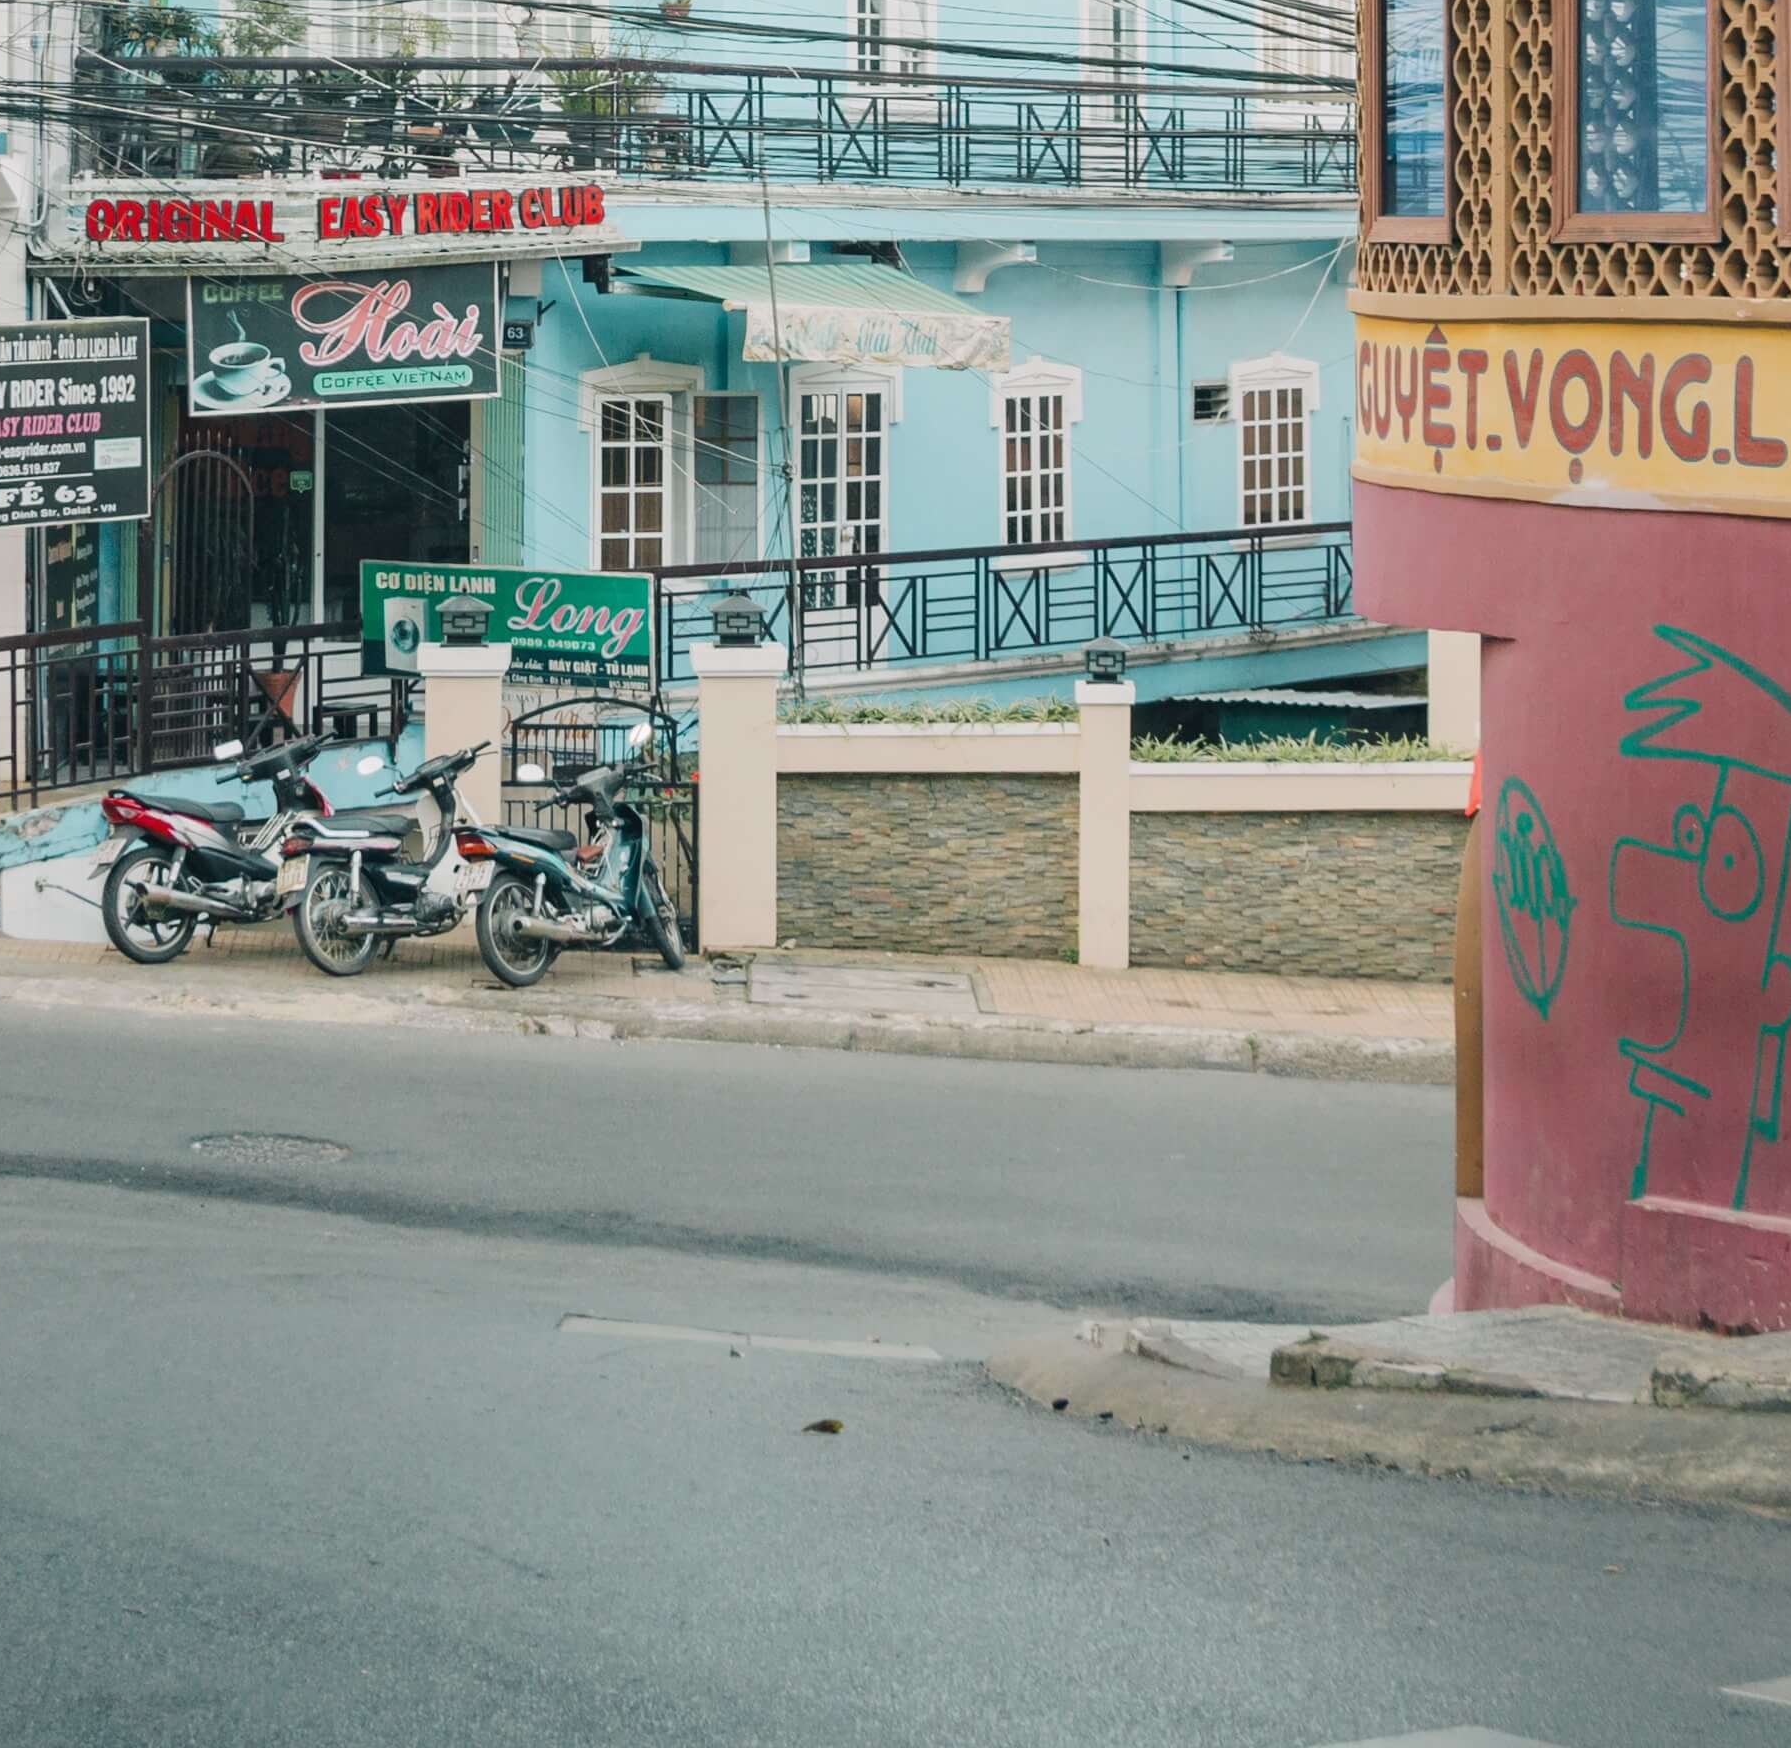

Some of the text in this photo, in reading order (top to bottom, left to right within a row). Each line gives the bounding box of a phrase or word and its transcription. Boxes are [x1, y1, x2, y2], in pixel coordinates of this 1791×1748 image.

[85, 184, 606, 244] ORIGINAL EASY RIDER CLUB
[291, 279, 484, 367] Hoài
[507, 327, 524, 339] 63
[10, 378, 55, 409] RIDER
[58, 376, 97, 407] Since
[100, 374, 136, 404] 1992
[22, 414, 64, 437] RIDER
[66, 411, 102, 433] CLUB
[55, 485, 98, 504] 63
[11, 509, 38, 521] Dinh
[62, 504, 91, 517] Dalat
[100, 502, 117, 514] VN
[375, 570, 401, 590] CƠ
[507, 577, 646, 659] Long
